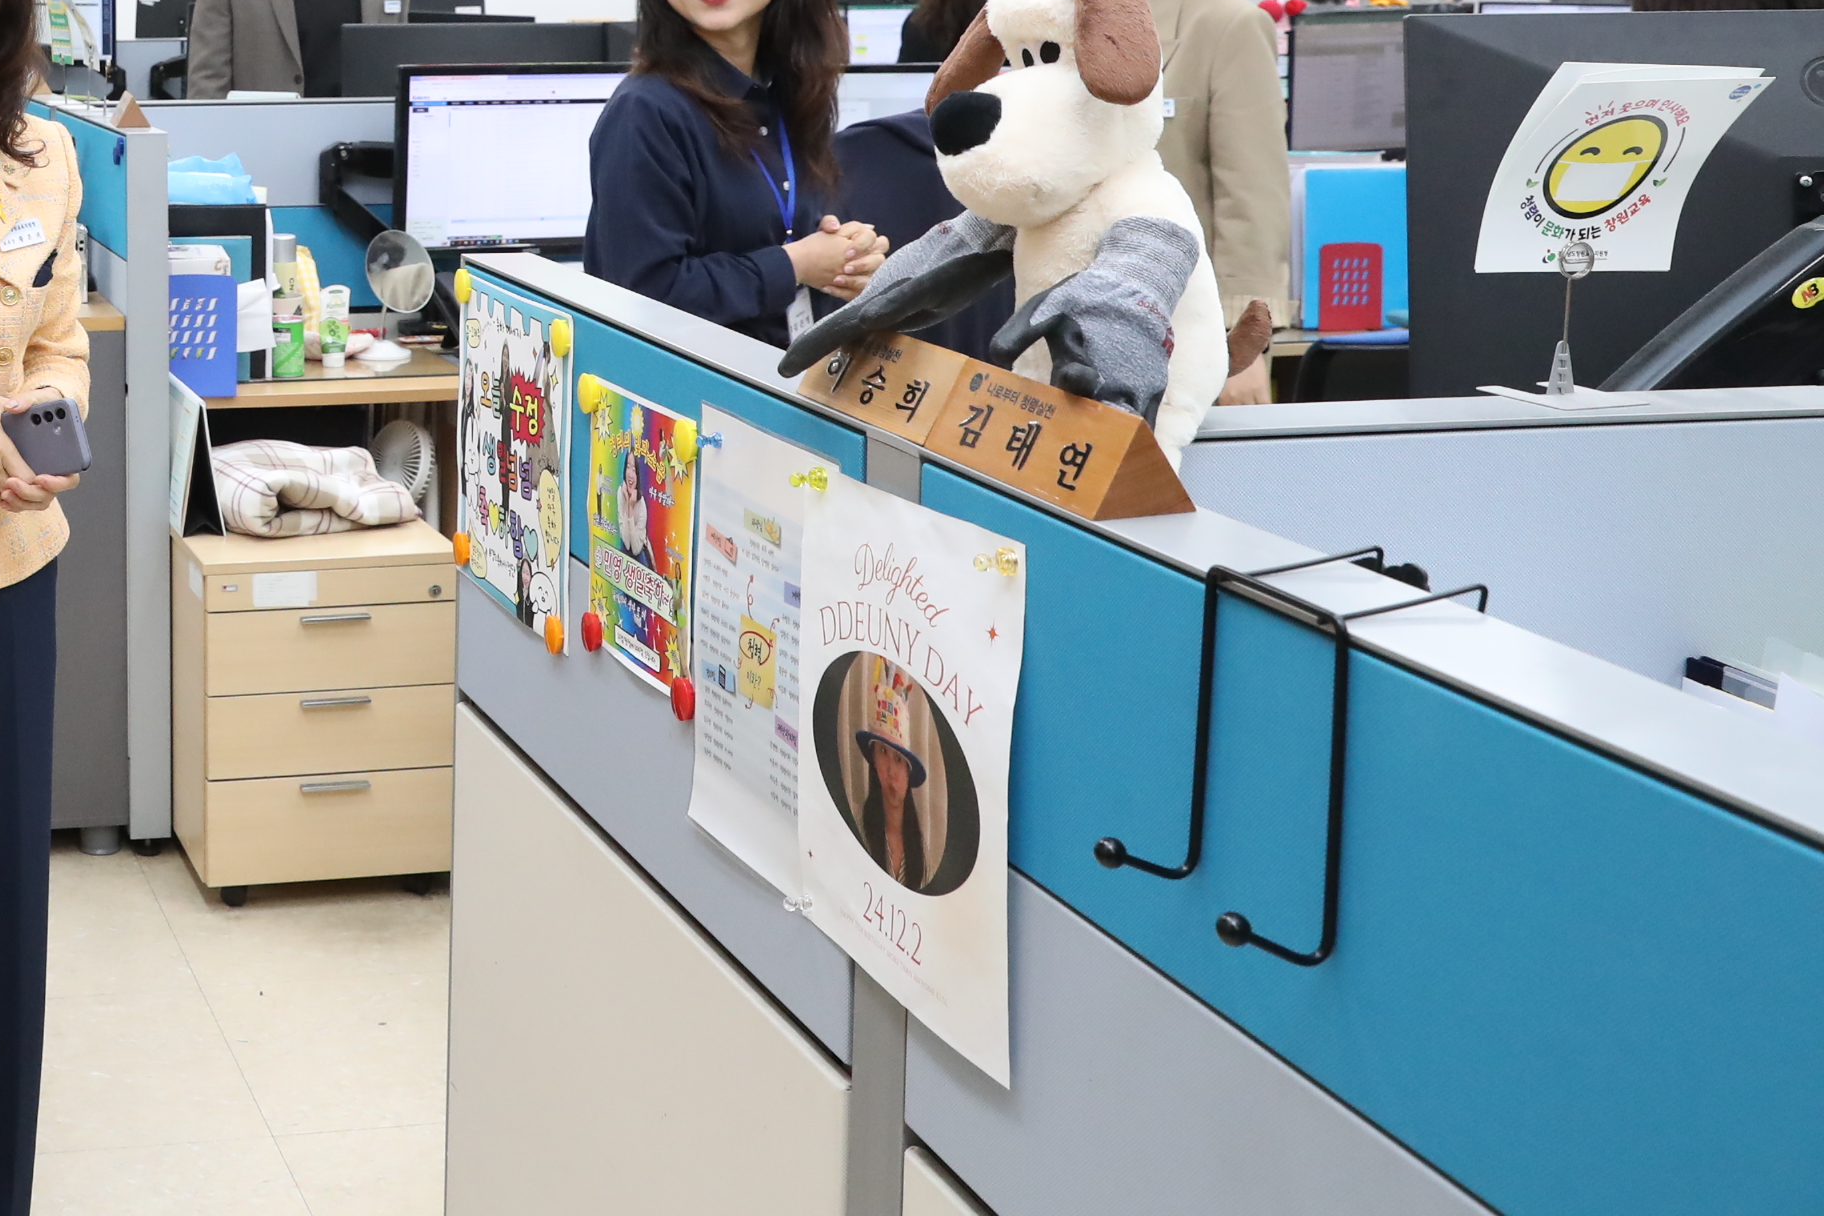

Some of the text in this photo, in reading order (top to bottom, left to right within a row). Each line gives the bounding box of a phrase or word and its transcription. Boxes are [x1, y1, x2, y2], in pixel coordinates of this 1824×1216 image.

[1585, 99, 1690, 126] 먼저 웃으며 인사해요
[1520, 193, 1651, 241] 청렴이 문화가 되는 창원교육
[480, 371, 502, 419] 오늘
[509, 385, 538, 435] 수정
[986, 382, 1057, 420] 나로부터 청렴실천
[854, 542, 950, 627] Delighted
[819, 601, 921, 667] DDEUNY
[924, 644, 984, 727] DAY
[863, 881, 923, 966] 24.12.2
